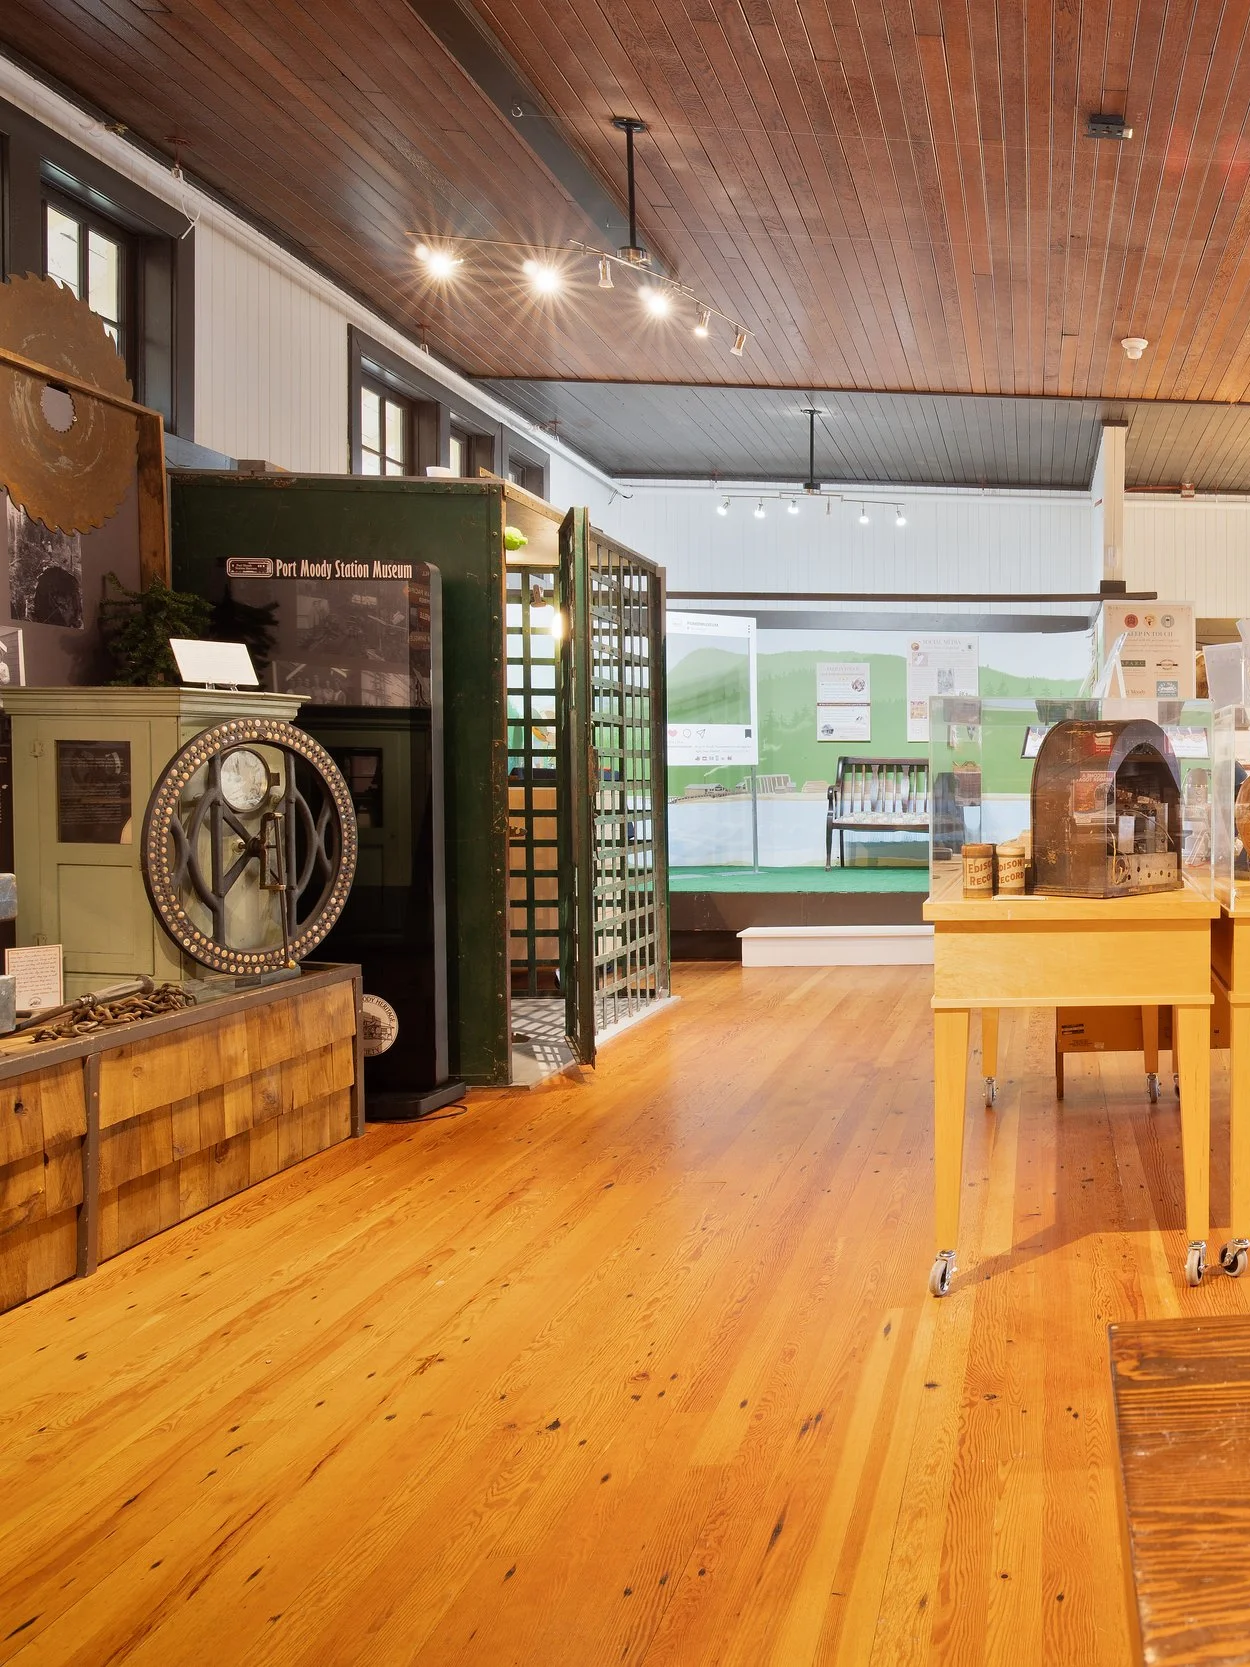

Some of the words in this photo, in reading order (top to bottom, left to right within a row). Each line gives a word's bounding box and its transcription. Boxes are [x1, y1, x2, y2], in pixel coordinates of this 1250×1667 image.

[276, 559, 297, 577] Port
[300, 559, 332, 580] Moody
[335, 560, 369, 578] Station
[373, 560, 413, 579] Museum
[968, 860, 992, 874] EDISO
[998, 859, 1023, 872] DISON
[970, 873, 992, 886] RECO
[999, 871, 1025, 884] ECORD
[376, 1000, 396, 1022] HERITAGE
